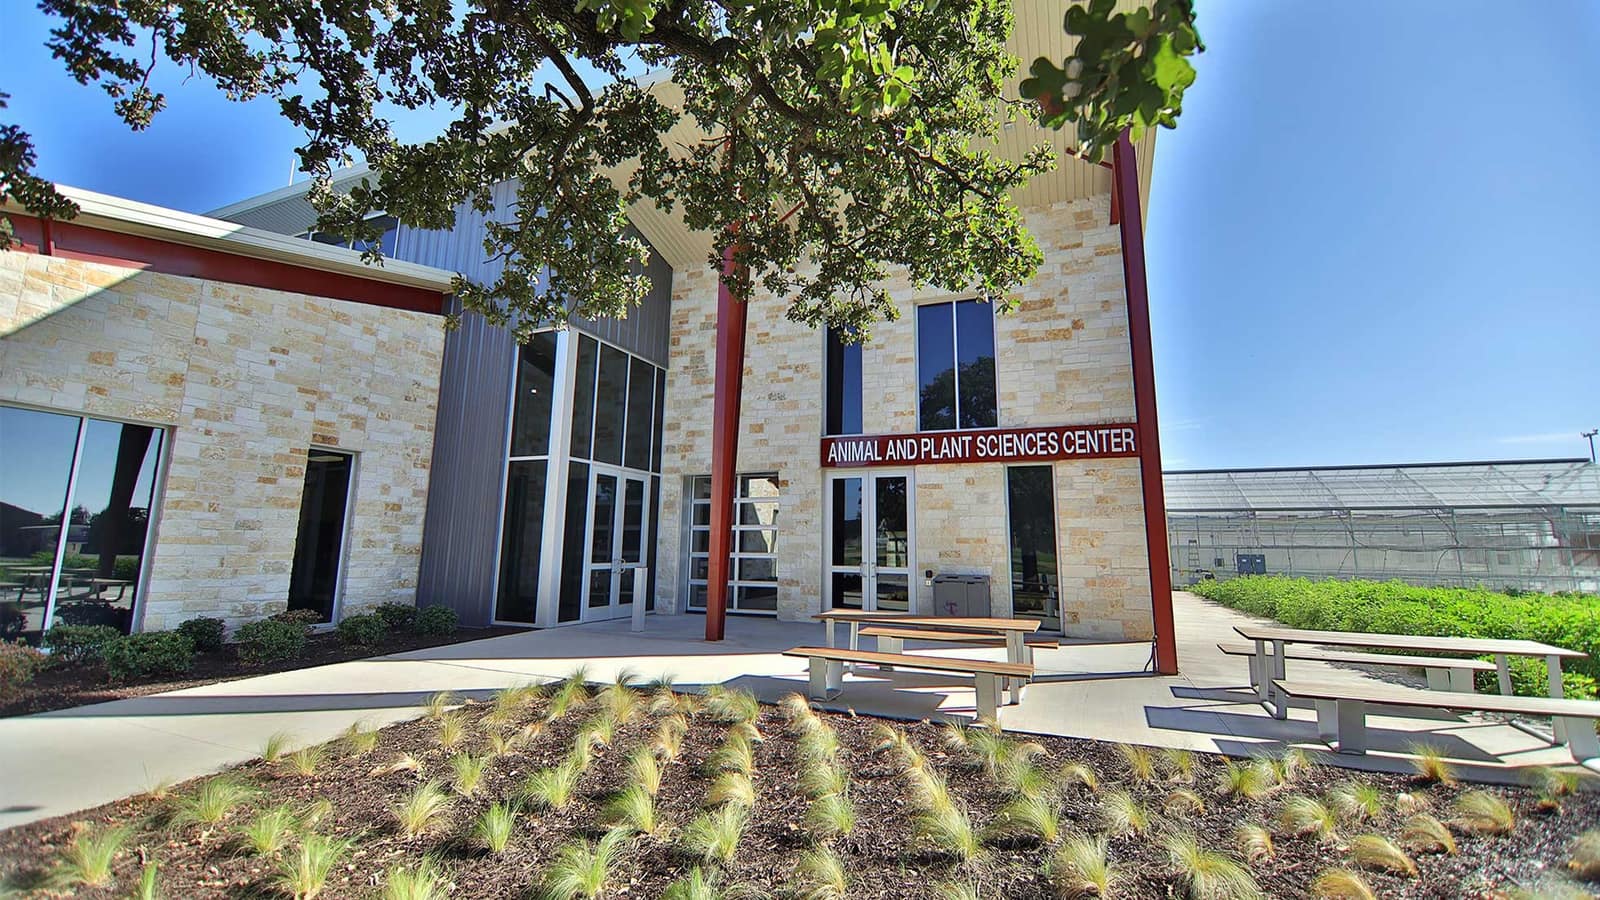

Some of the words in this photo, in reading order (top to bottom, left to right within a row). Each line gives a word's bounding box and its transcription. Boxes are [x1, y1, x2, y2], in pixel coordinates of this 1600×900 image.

[828, 438, 882, 462] ANIMAL
[886, 438, 917, 460] AND
[921, 435, 972, 459] PLANT
[976, 432, 1059, 455] SCIENCES
[1062, 428, 1136, 453] CENTER
